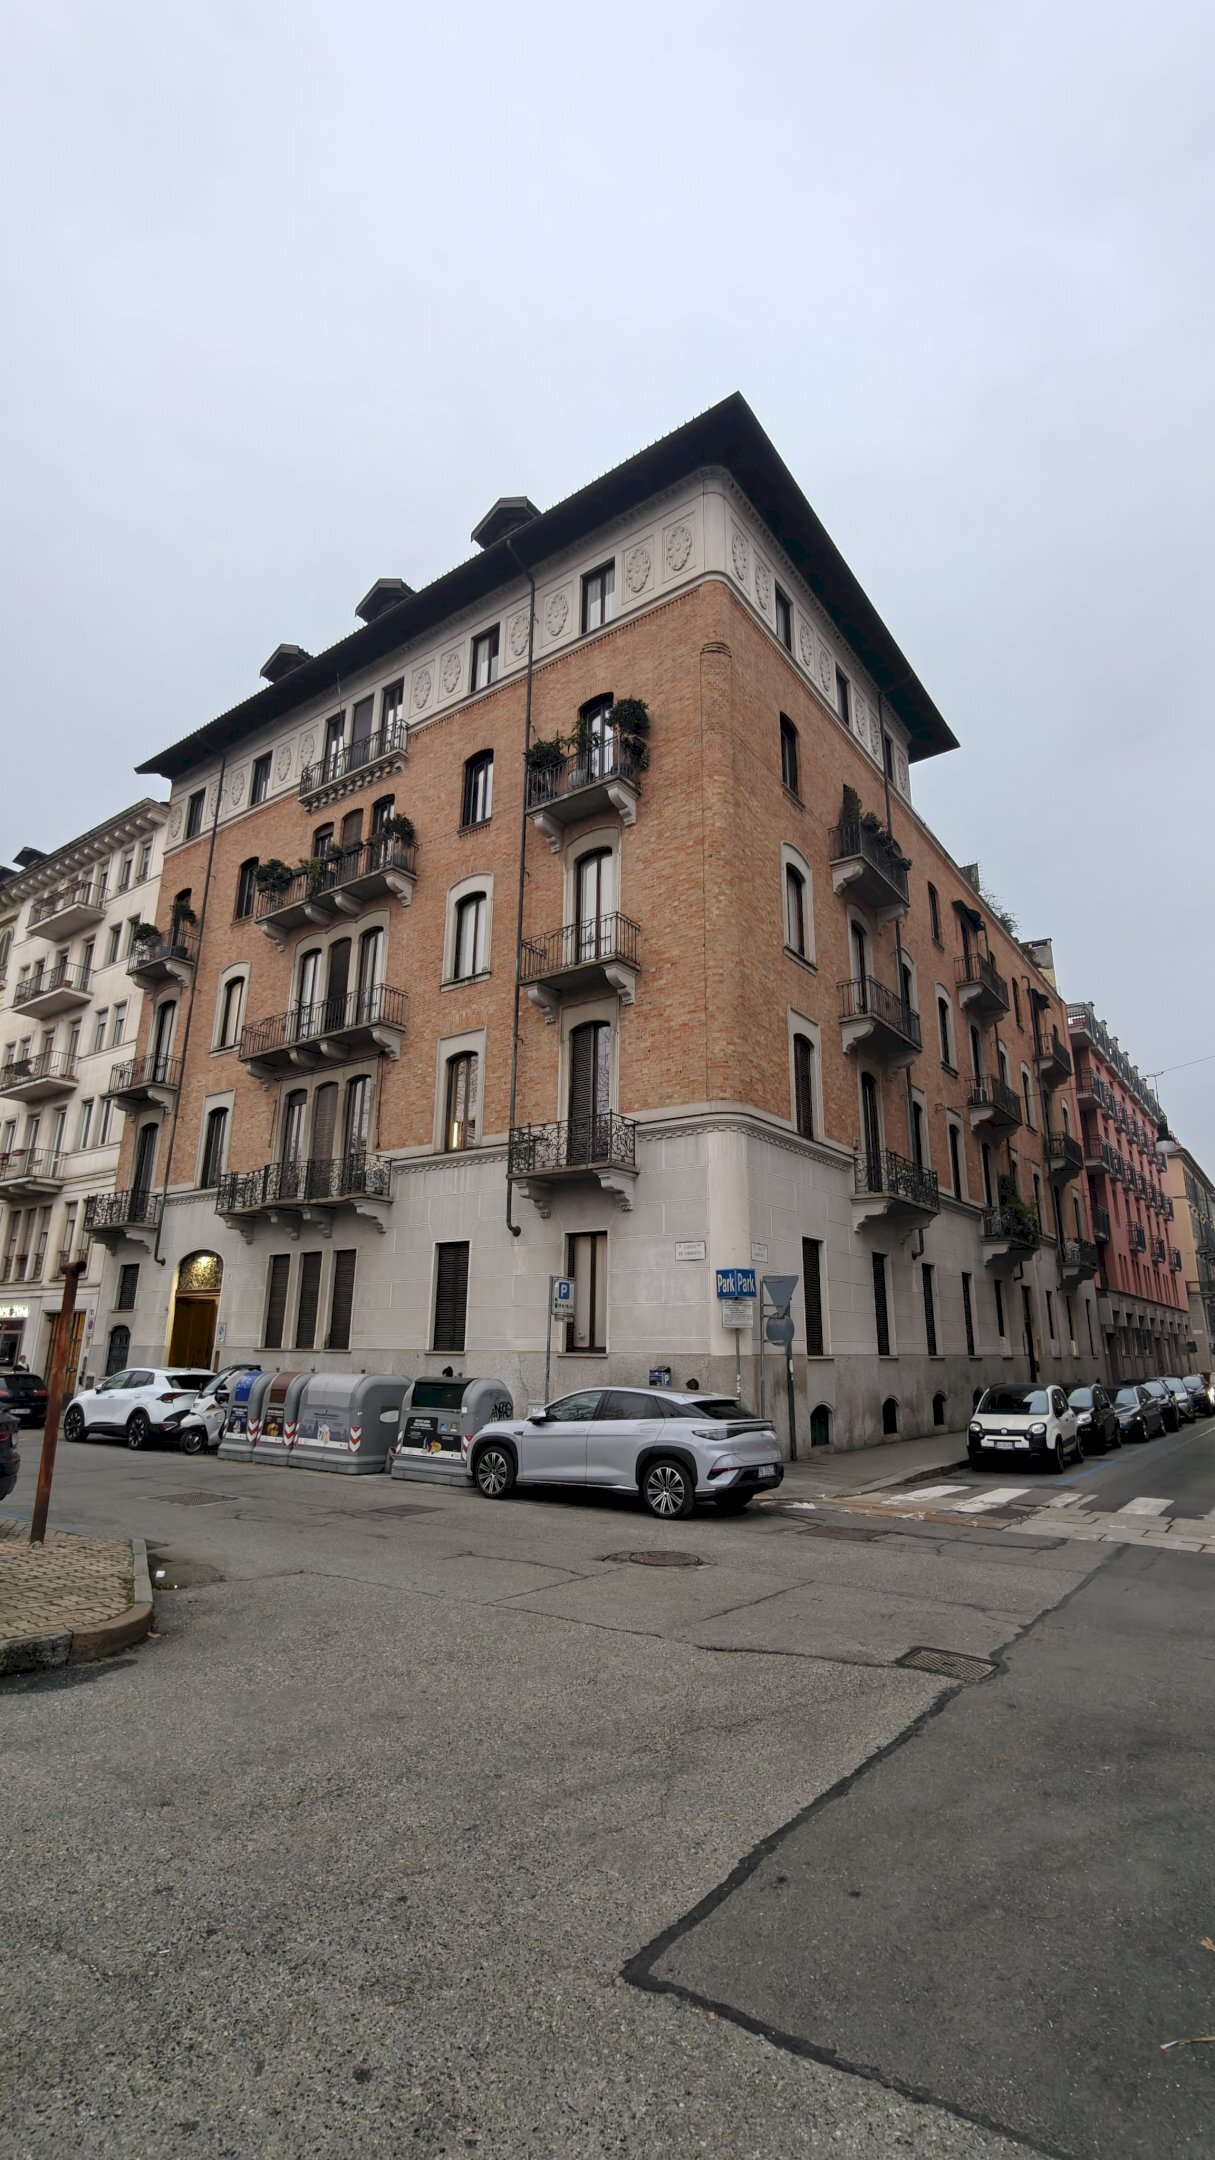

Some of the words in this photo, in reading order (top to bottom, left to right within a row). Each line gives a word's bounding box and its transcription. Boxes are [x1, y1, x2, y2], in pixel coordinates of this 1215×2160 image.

[560, 1284, 568, 1298] P
[717, 1273, 735, 1293] Park
[737, 1273, 755, 1292] Park
